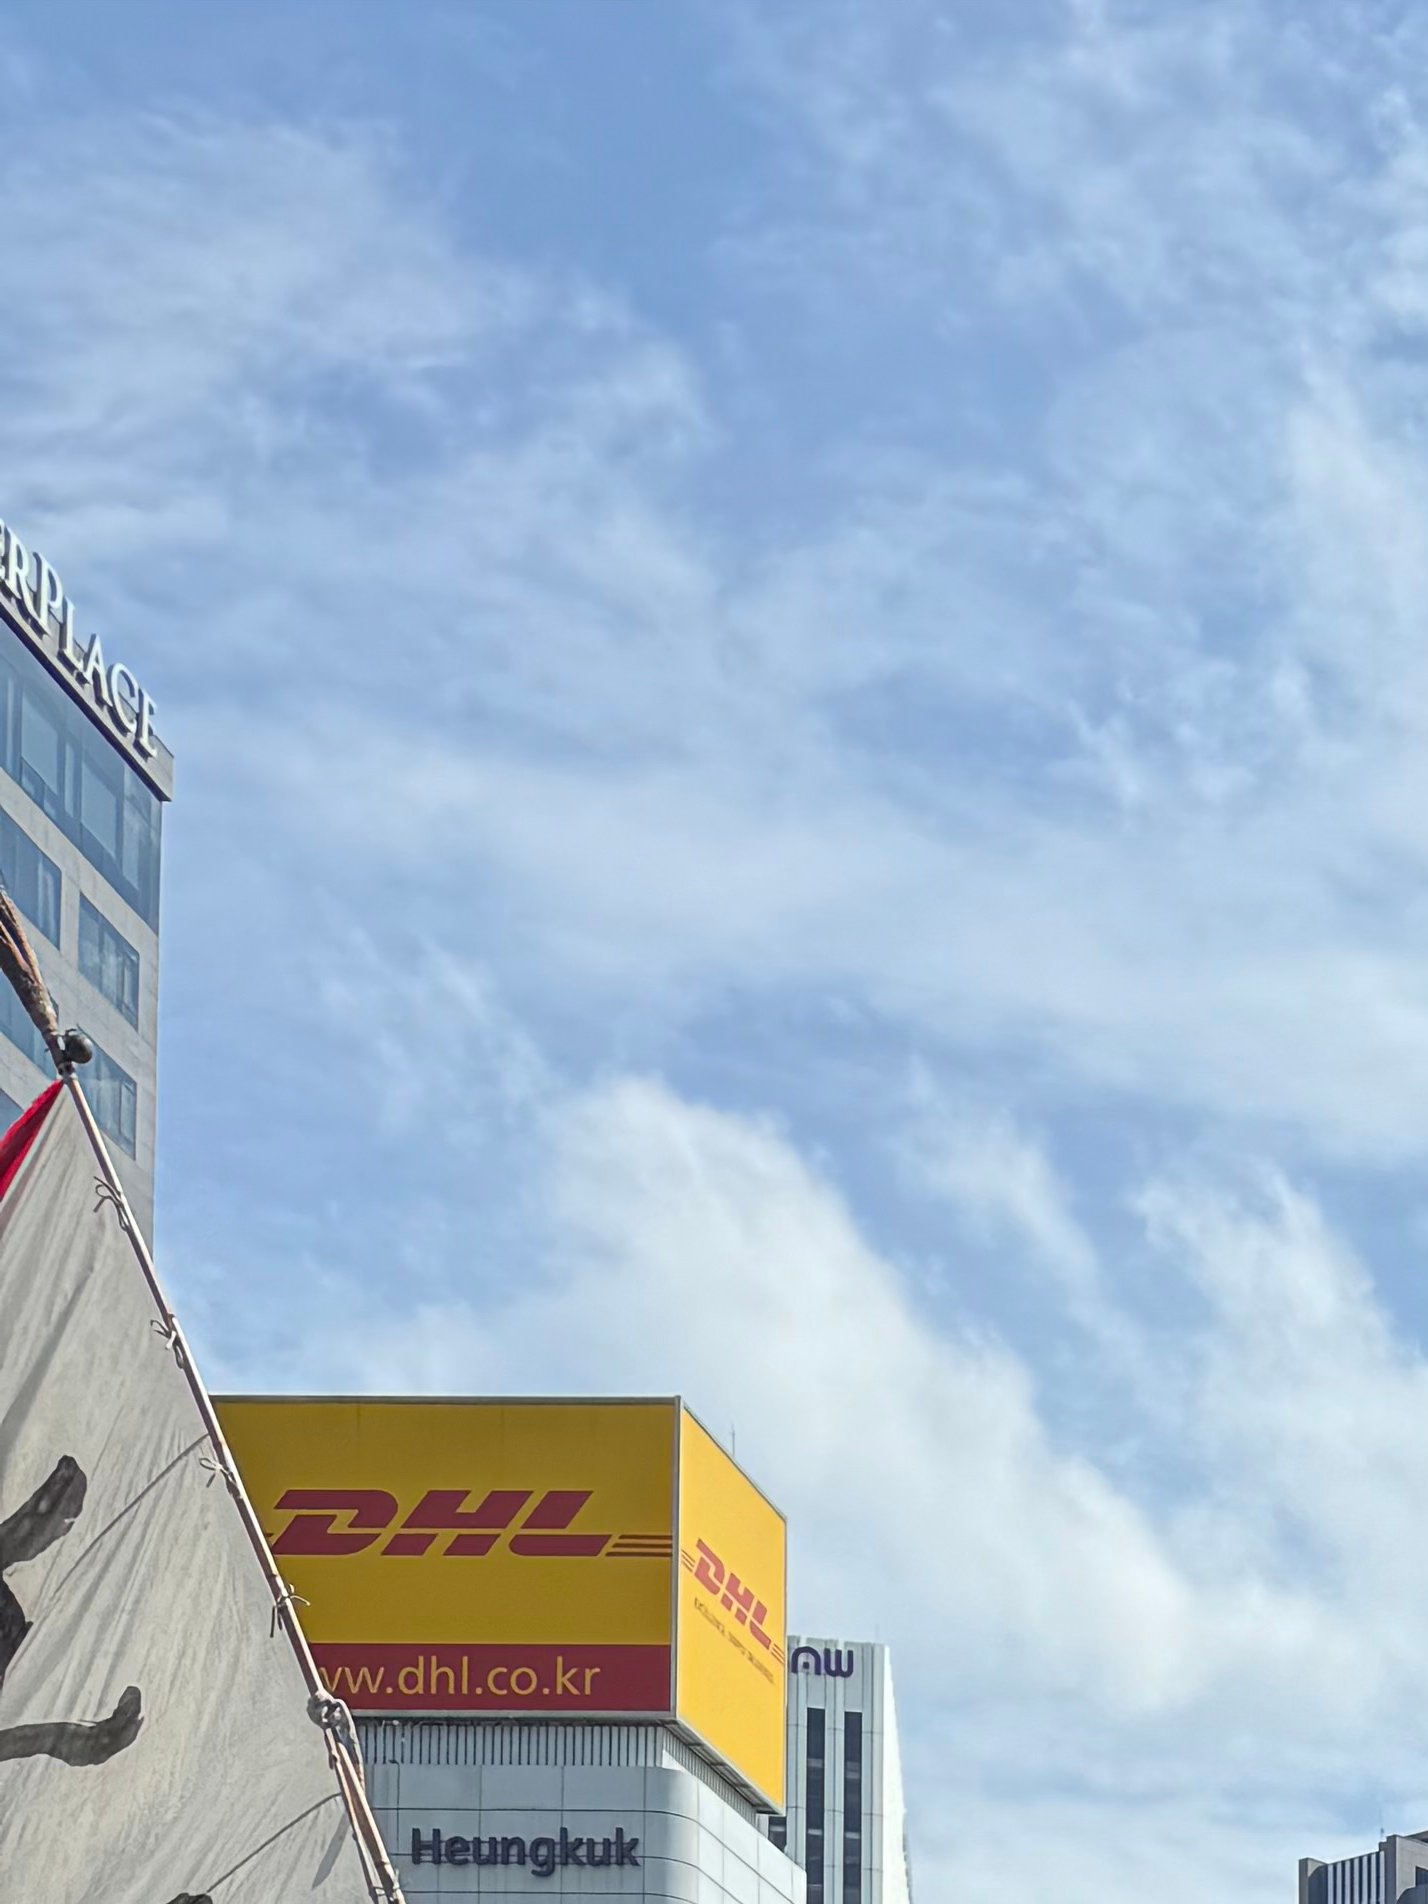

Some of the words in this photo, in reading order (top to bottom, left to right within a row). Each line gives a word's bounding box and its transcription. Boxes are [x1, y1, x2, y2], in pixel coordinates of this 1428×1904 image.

[0, 518, 157, 757] RPLACE
[272, 1488, 612, 1557] DHL
[694, 1538, 772, 1650] DHL
[318, 1655, 600, 1696] w.dhl.co.kr
[411, 1827, 642, 1877] Heungkuk
